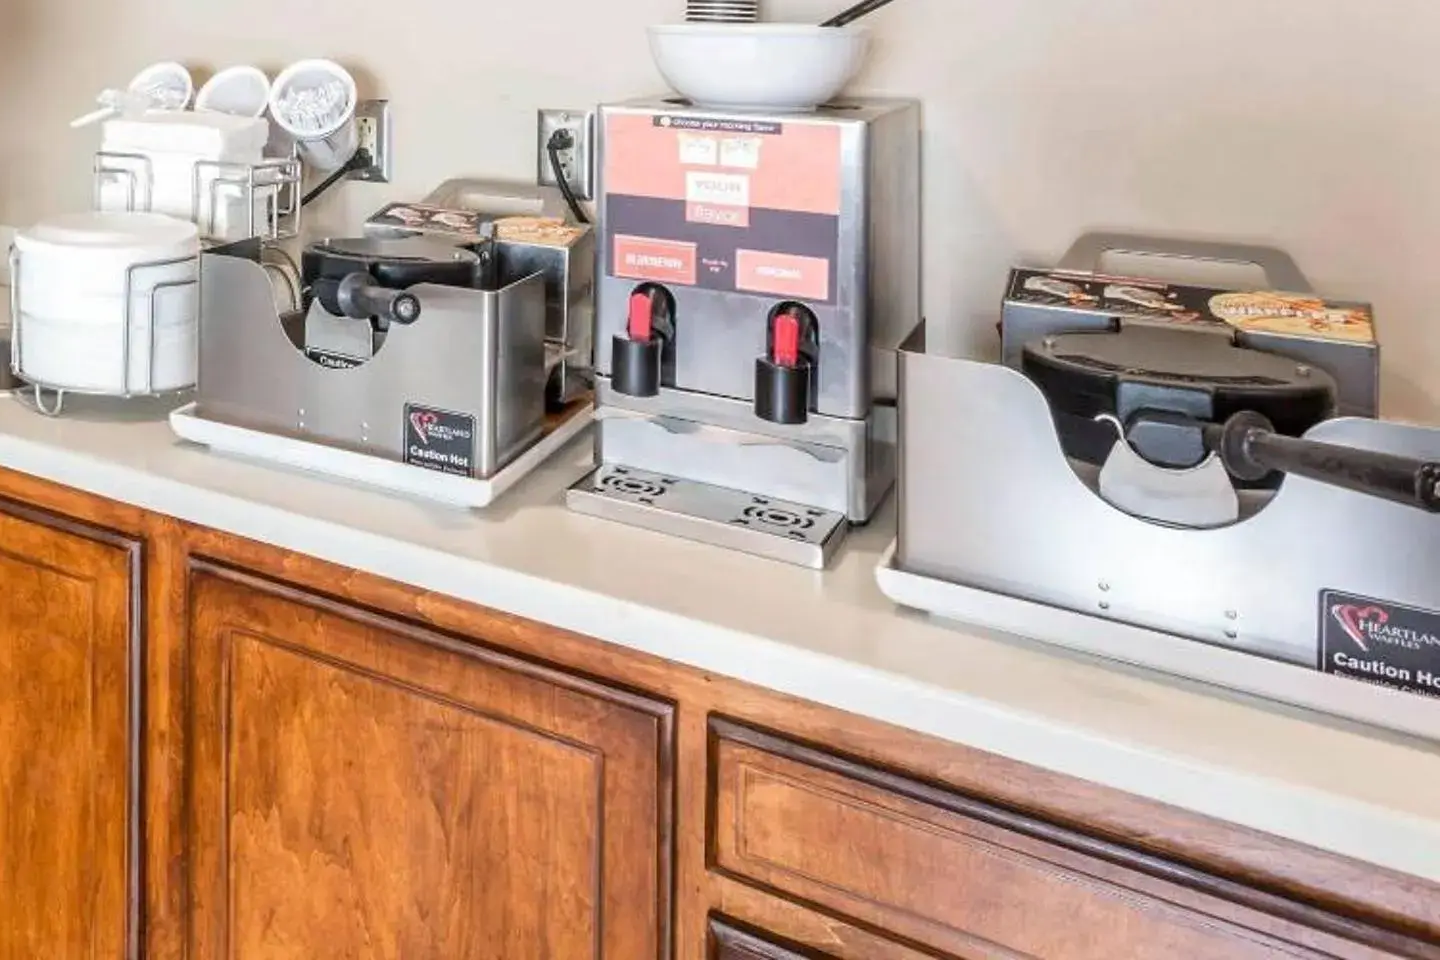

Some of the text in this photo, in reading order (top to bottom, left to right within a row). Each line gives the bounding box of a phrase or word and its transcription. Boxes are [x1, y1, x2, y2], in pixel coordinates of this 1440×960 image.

[410, 445, 448, 462] Caution
[449, 453, 468, 467] Hot
[1368, 631, 1420, 650] WAFFLES
[1333, 652, 1410, 681] Caution
